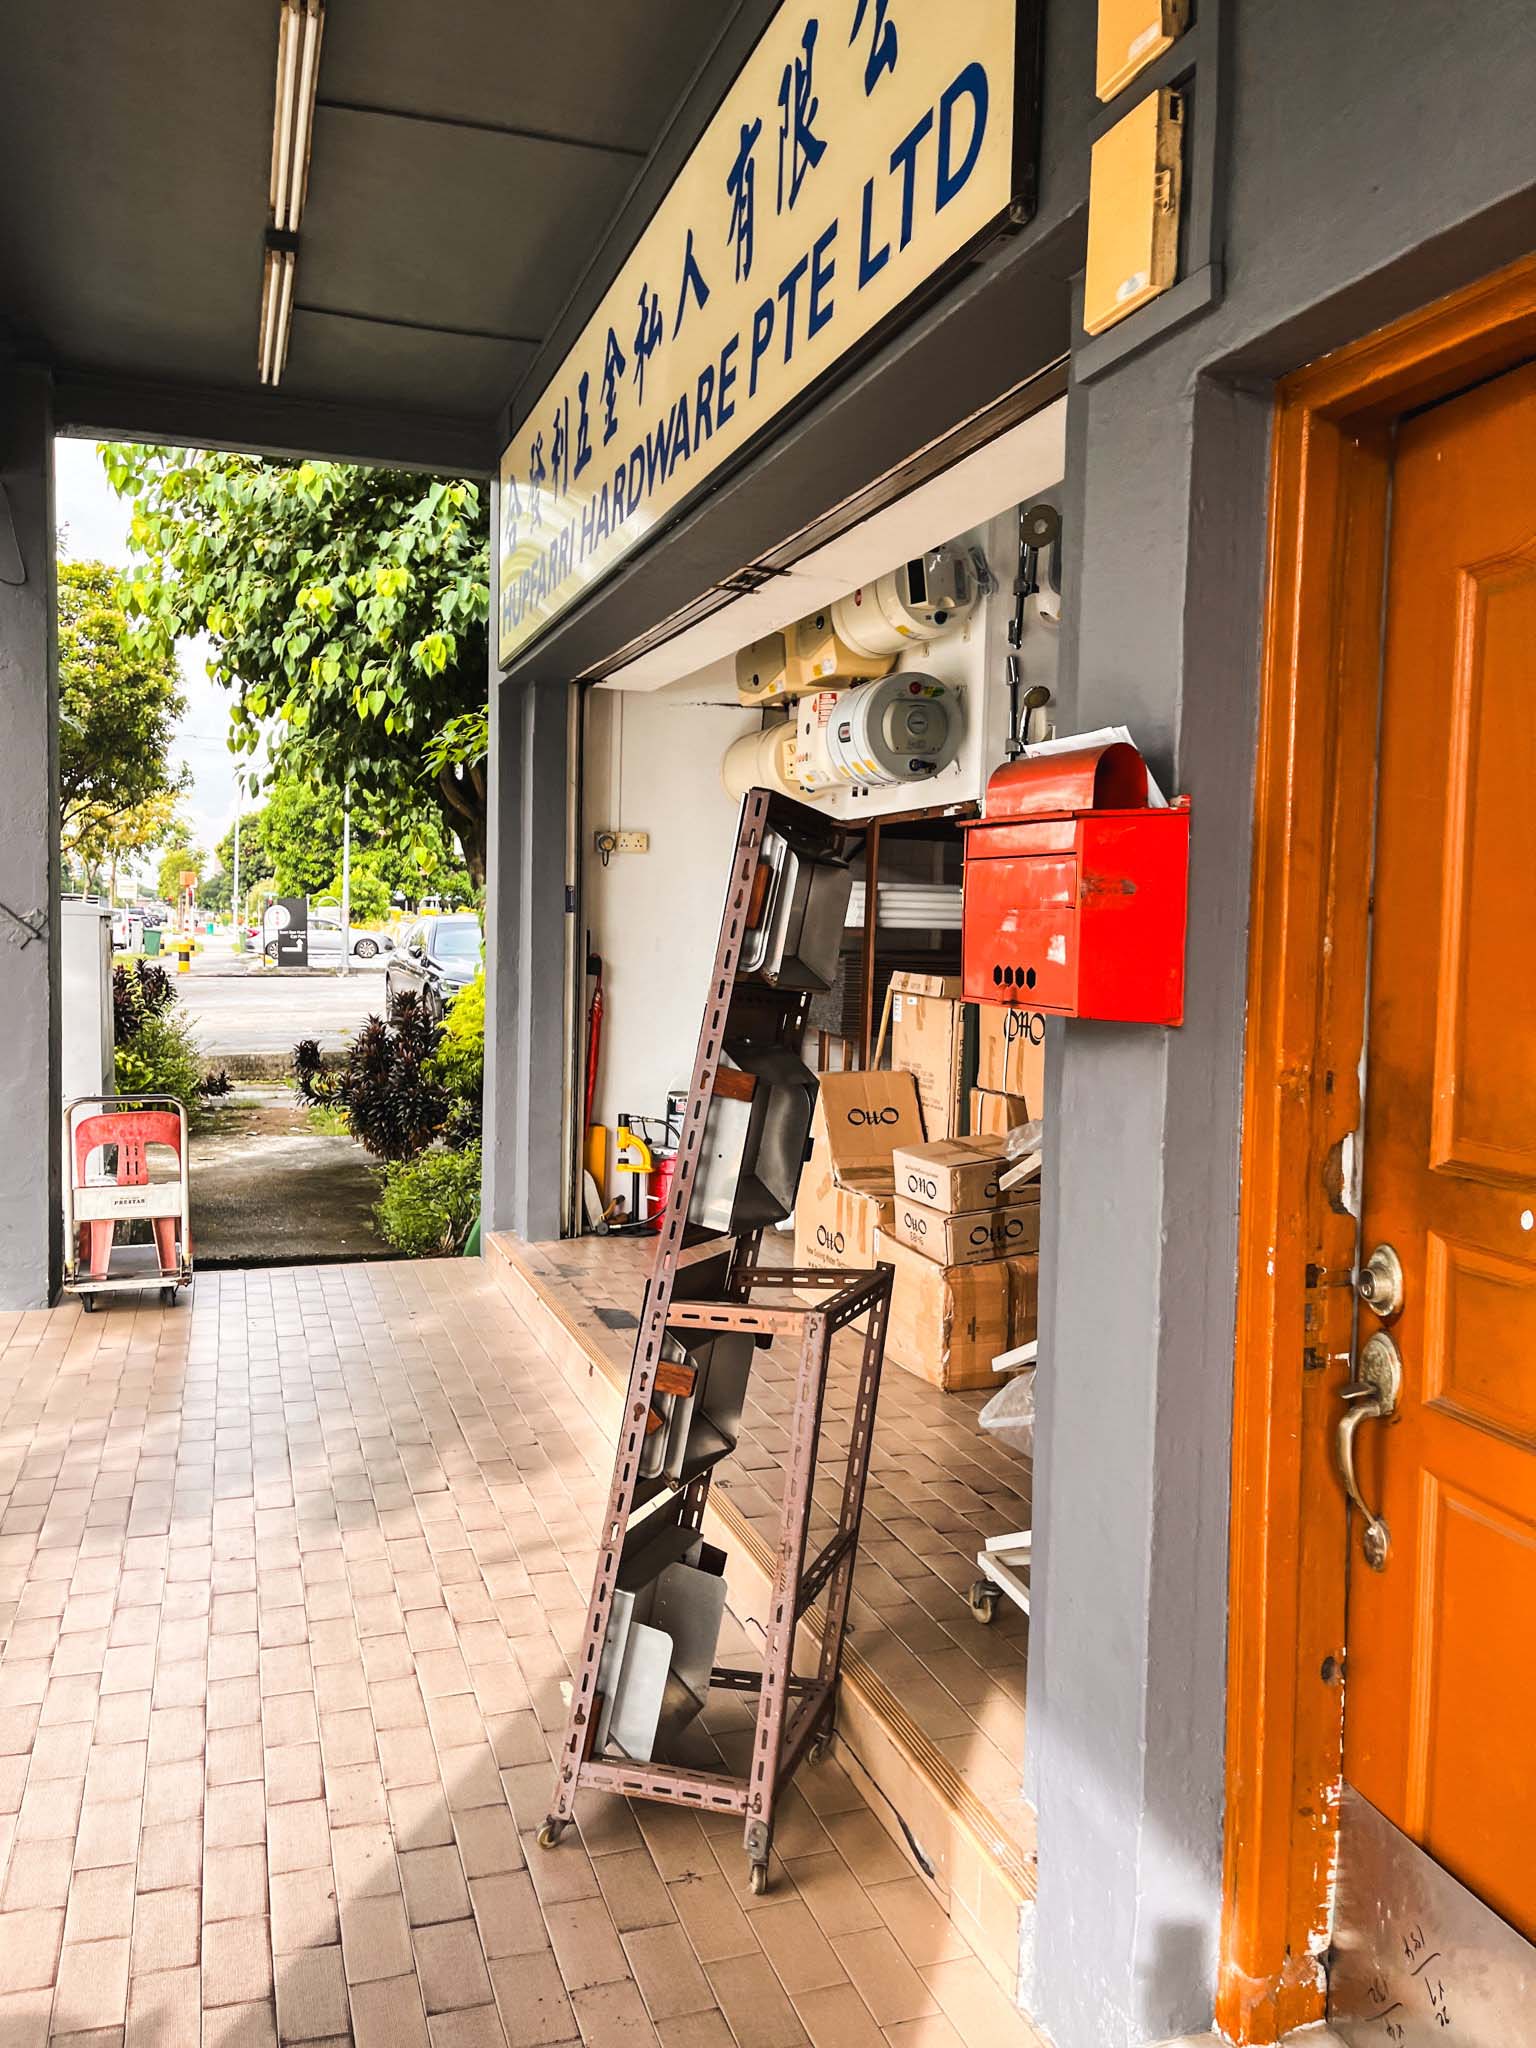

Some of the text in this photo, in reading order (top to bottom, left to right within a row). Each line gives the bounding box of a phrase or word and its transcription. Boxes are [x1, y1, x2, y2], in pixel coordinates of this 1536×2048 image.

[579, 331, 739, 563] HARDWARE
[748, 217, 838, 399] PTE
[858, 62, 989, 291] LTD
